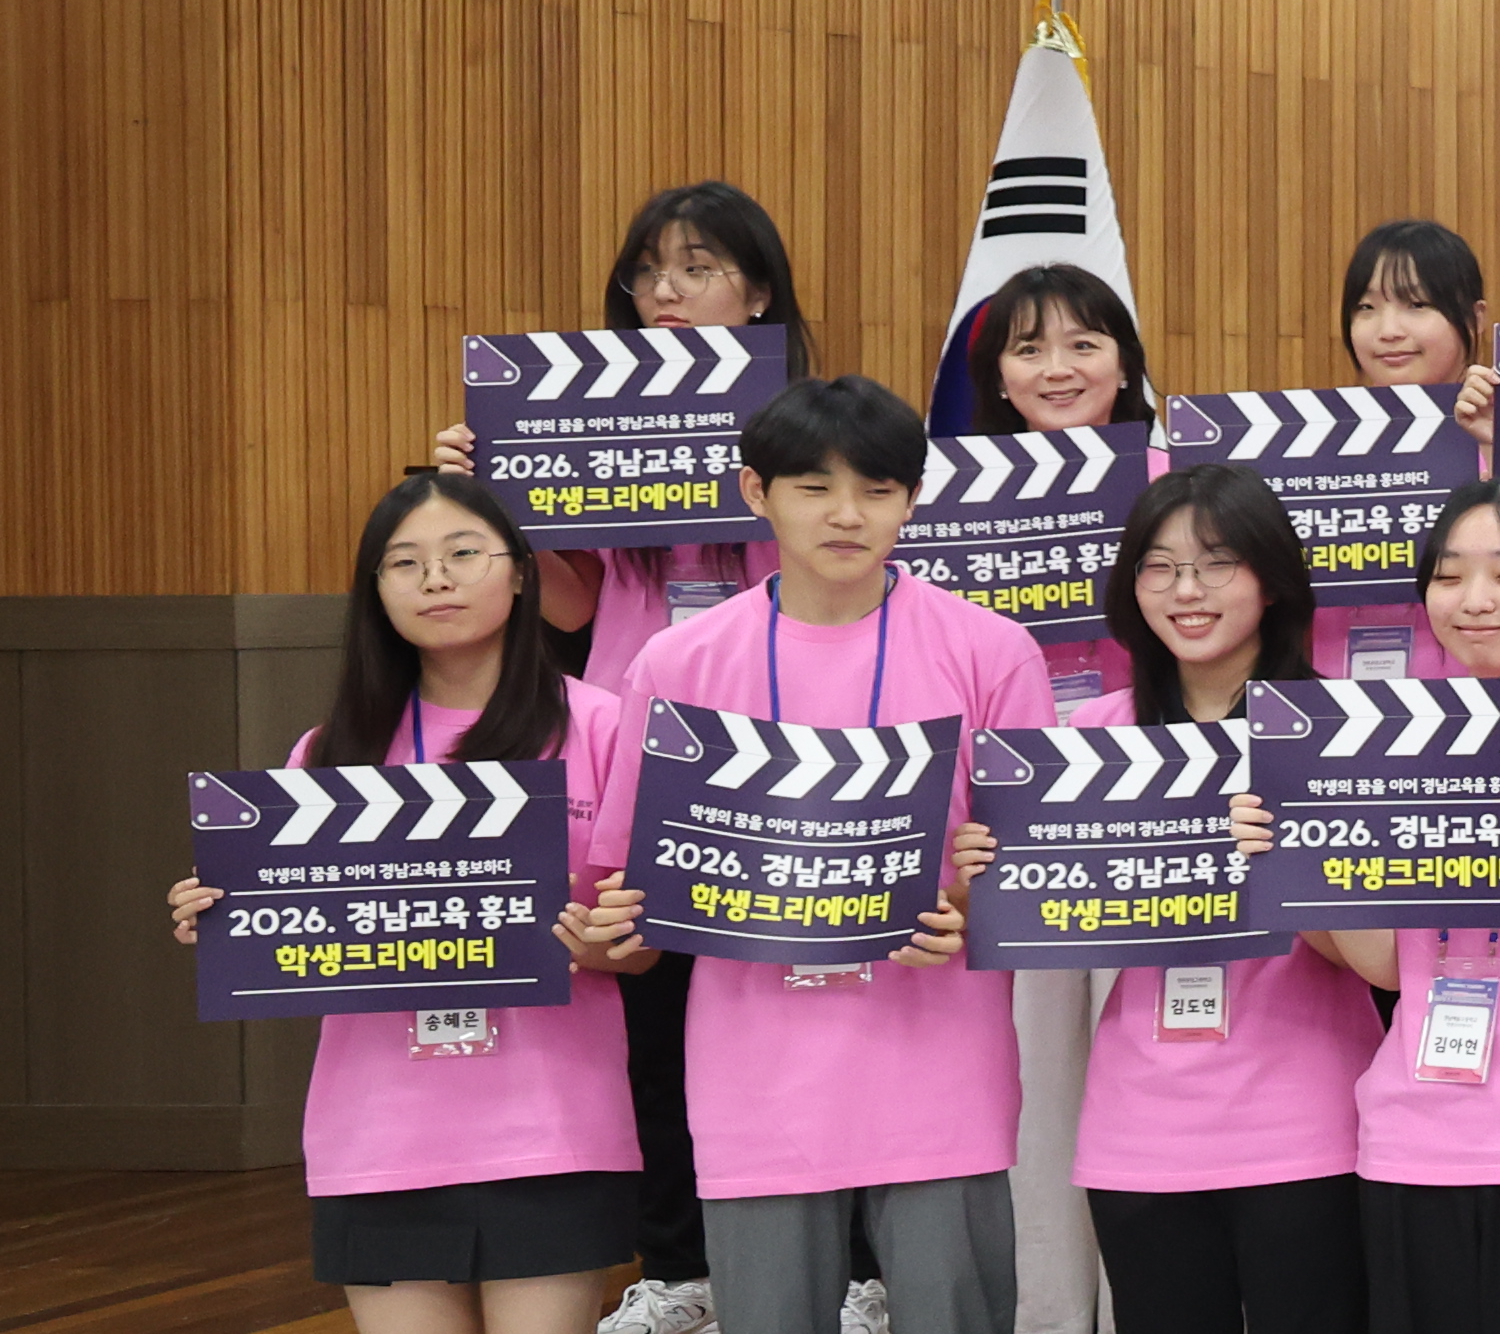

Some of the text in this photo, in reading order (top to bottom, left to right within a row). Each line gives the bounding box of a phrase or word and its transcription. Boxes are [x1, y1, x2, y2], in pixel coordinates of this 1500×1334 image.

[1280, 820, 1379, 847] 2026.
[1390, 814, 1500, 849] 경남교육
[258, 859, 512, 884] 학생의 꿈을 이어 경남교육을 홍보하다
[229, 896, 535, 936] 2026. 경남교육 홍보
[276, 937, 493, 976] 학생크리에이터
[1170, 997, 1216, 1016] 김도연
[425, 1010, 480, 1032] 송혜은
[1434, 1036, 1479, 1056] 김아현
